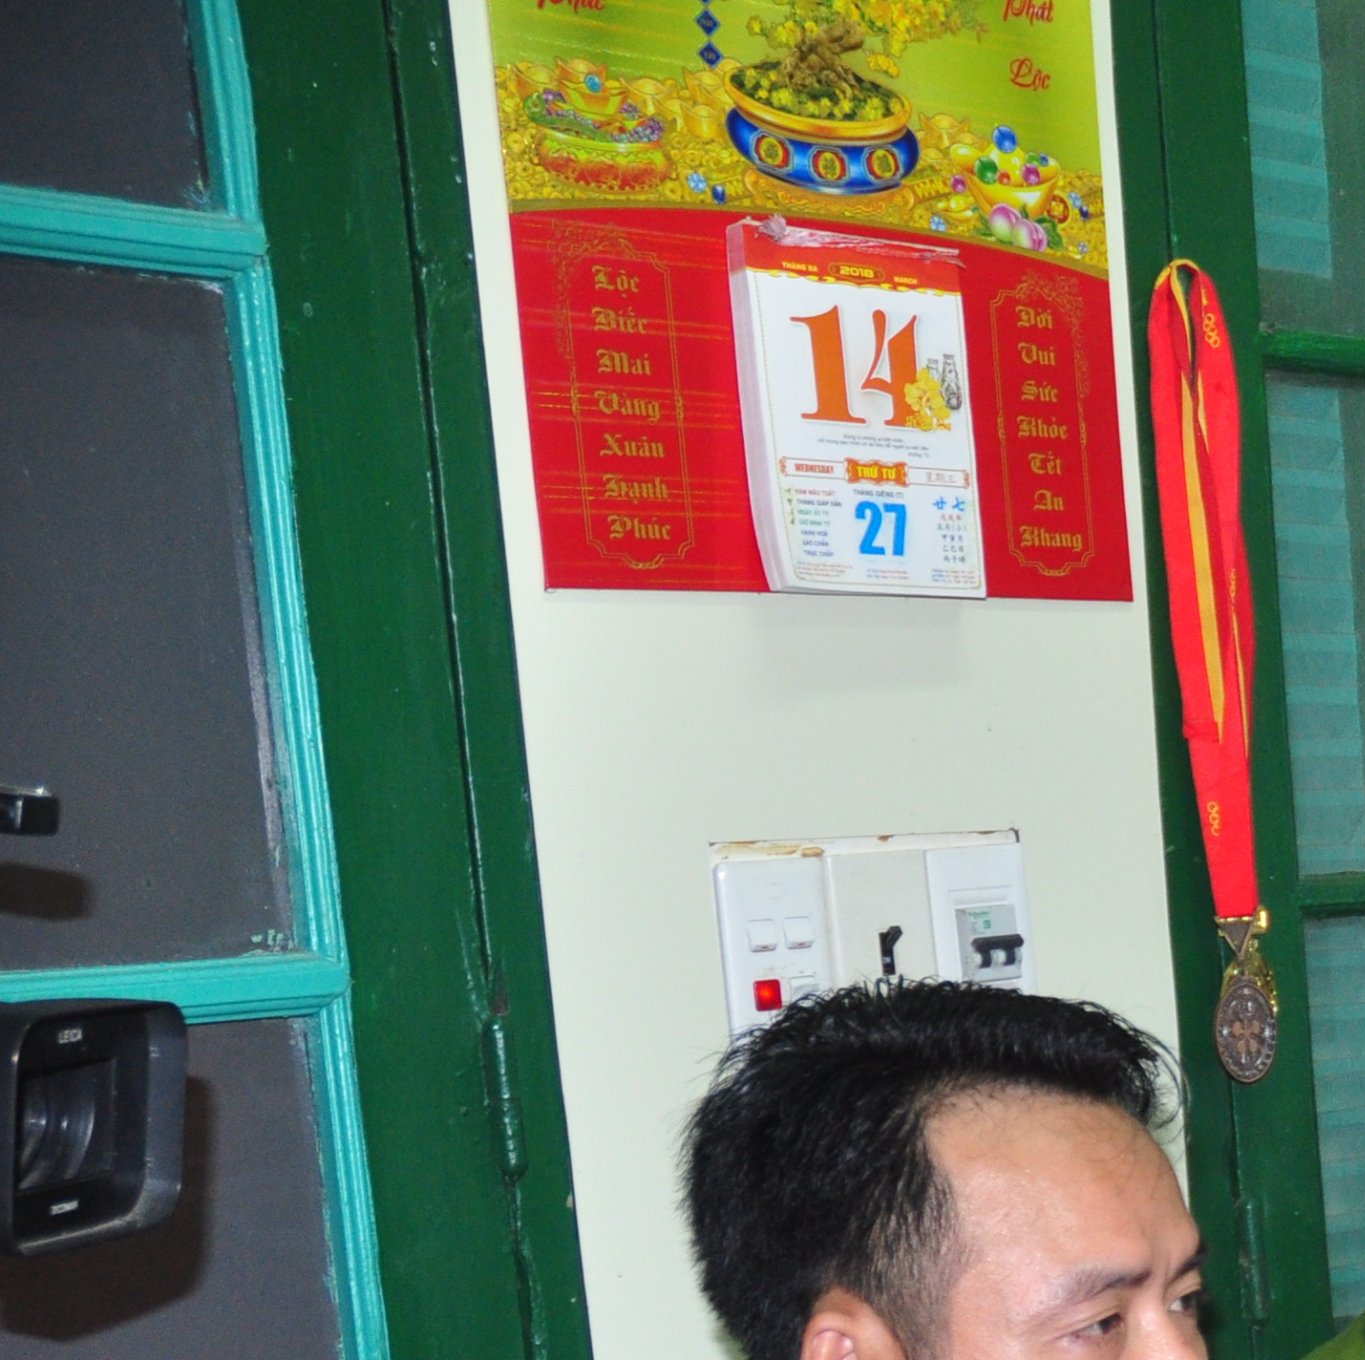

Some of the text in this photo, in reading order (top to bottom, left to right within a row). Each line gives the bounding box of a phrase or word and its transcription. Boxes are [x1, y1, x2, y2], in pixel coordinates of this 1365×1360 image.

[839, 265, 875, 279] 2018
[596, 349, 651, 375] Mai
[789, 304, 920, 429] 14
[854, 500, 907, 556] 27
